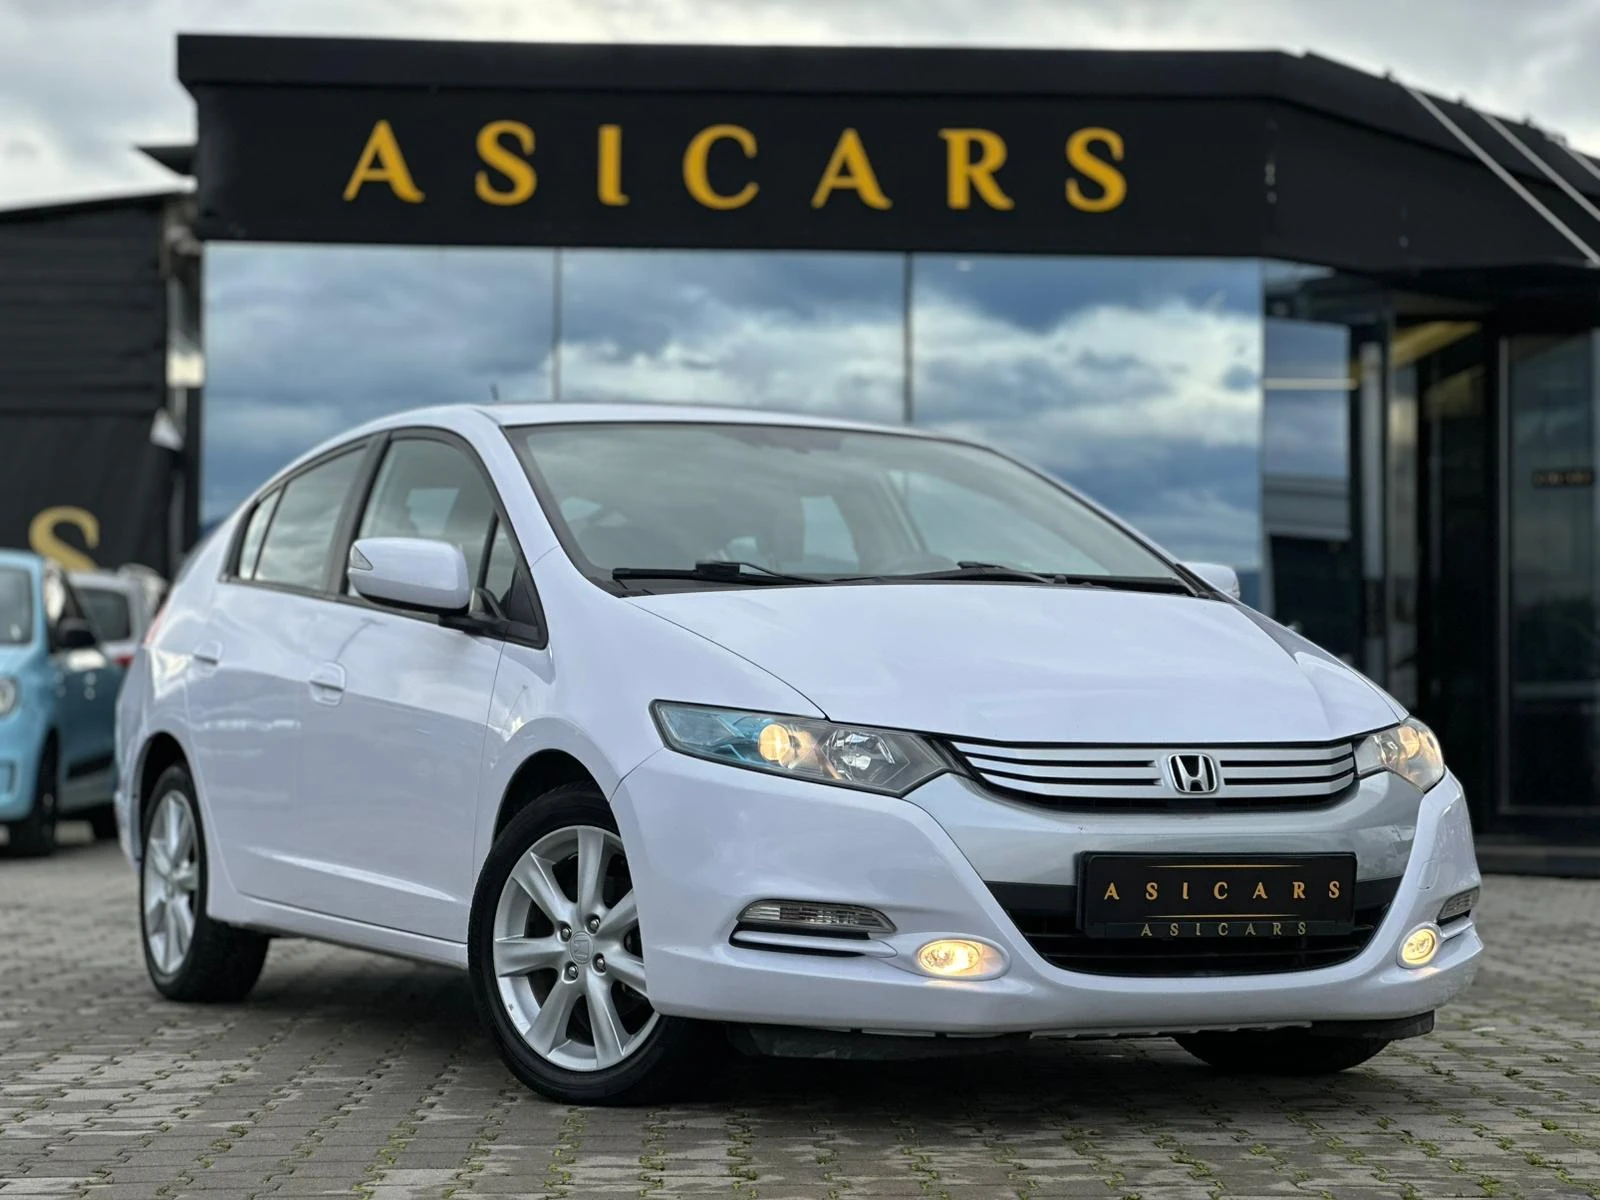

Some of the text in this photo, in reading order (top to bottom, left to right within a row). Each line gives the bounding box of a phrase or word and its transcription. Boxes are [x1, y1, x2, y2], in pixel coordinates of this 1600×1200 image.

[343, 119, 1128, 212] ASICARS
[1103, 880, 1341, 901] ASICARS
[1140, 922, 1307, 937] ASICARS
